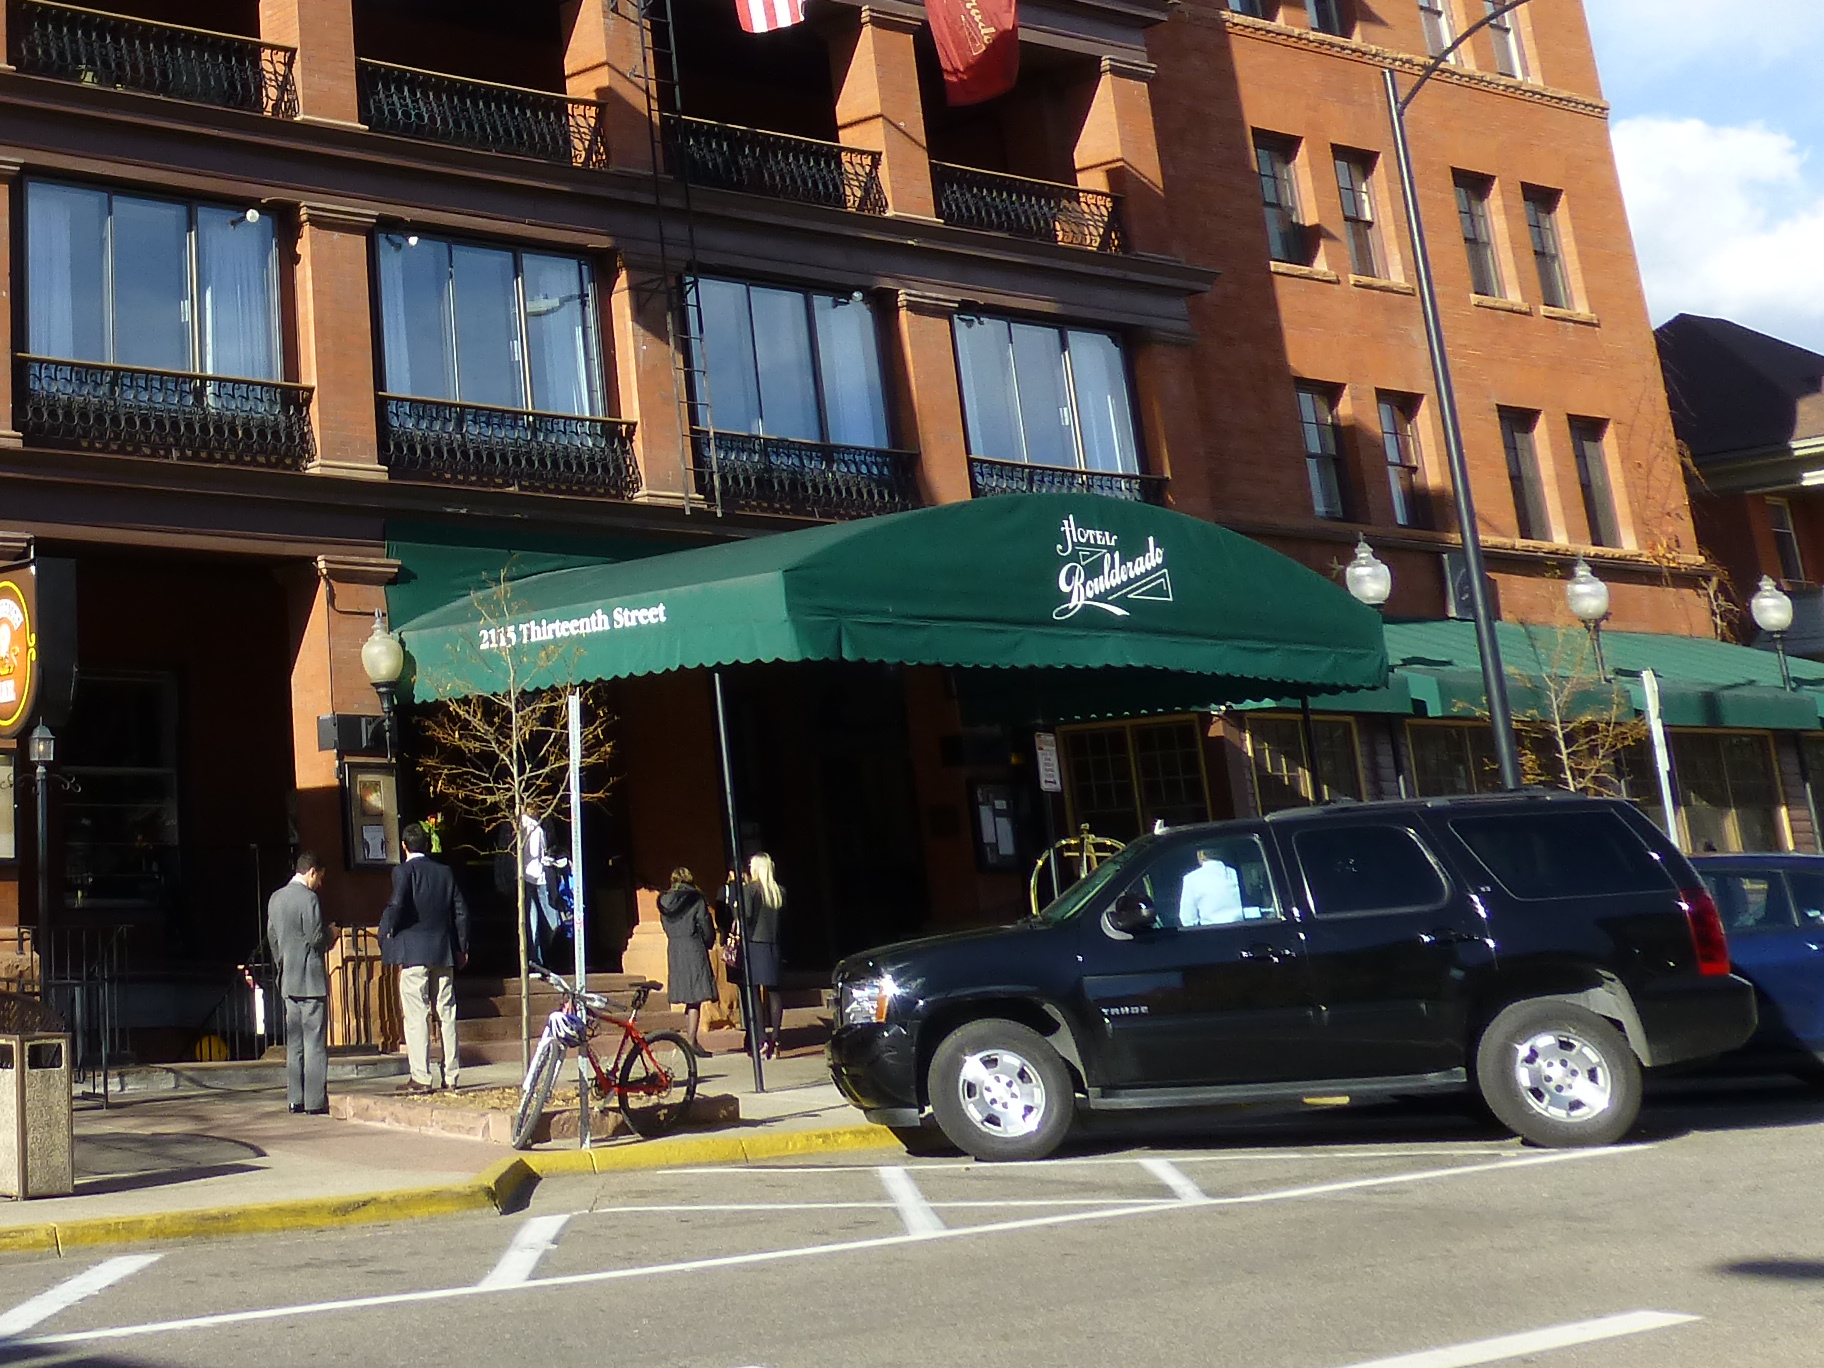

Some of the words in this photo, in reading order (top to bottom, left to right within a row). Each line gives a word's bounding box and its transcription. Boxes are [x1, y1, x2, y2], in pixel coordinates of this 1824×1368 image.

[1053, 535, 1165, 620] Boulderado
[479, 624, 517, 650] 2115
[519, 608, 610, 644] Thirteenth
[613, 602, 667, 629] Street
[1101, 1005, 1149, 1016] TAHOE
